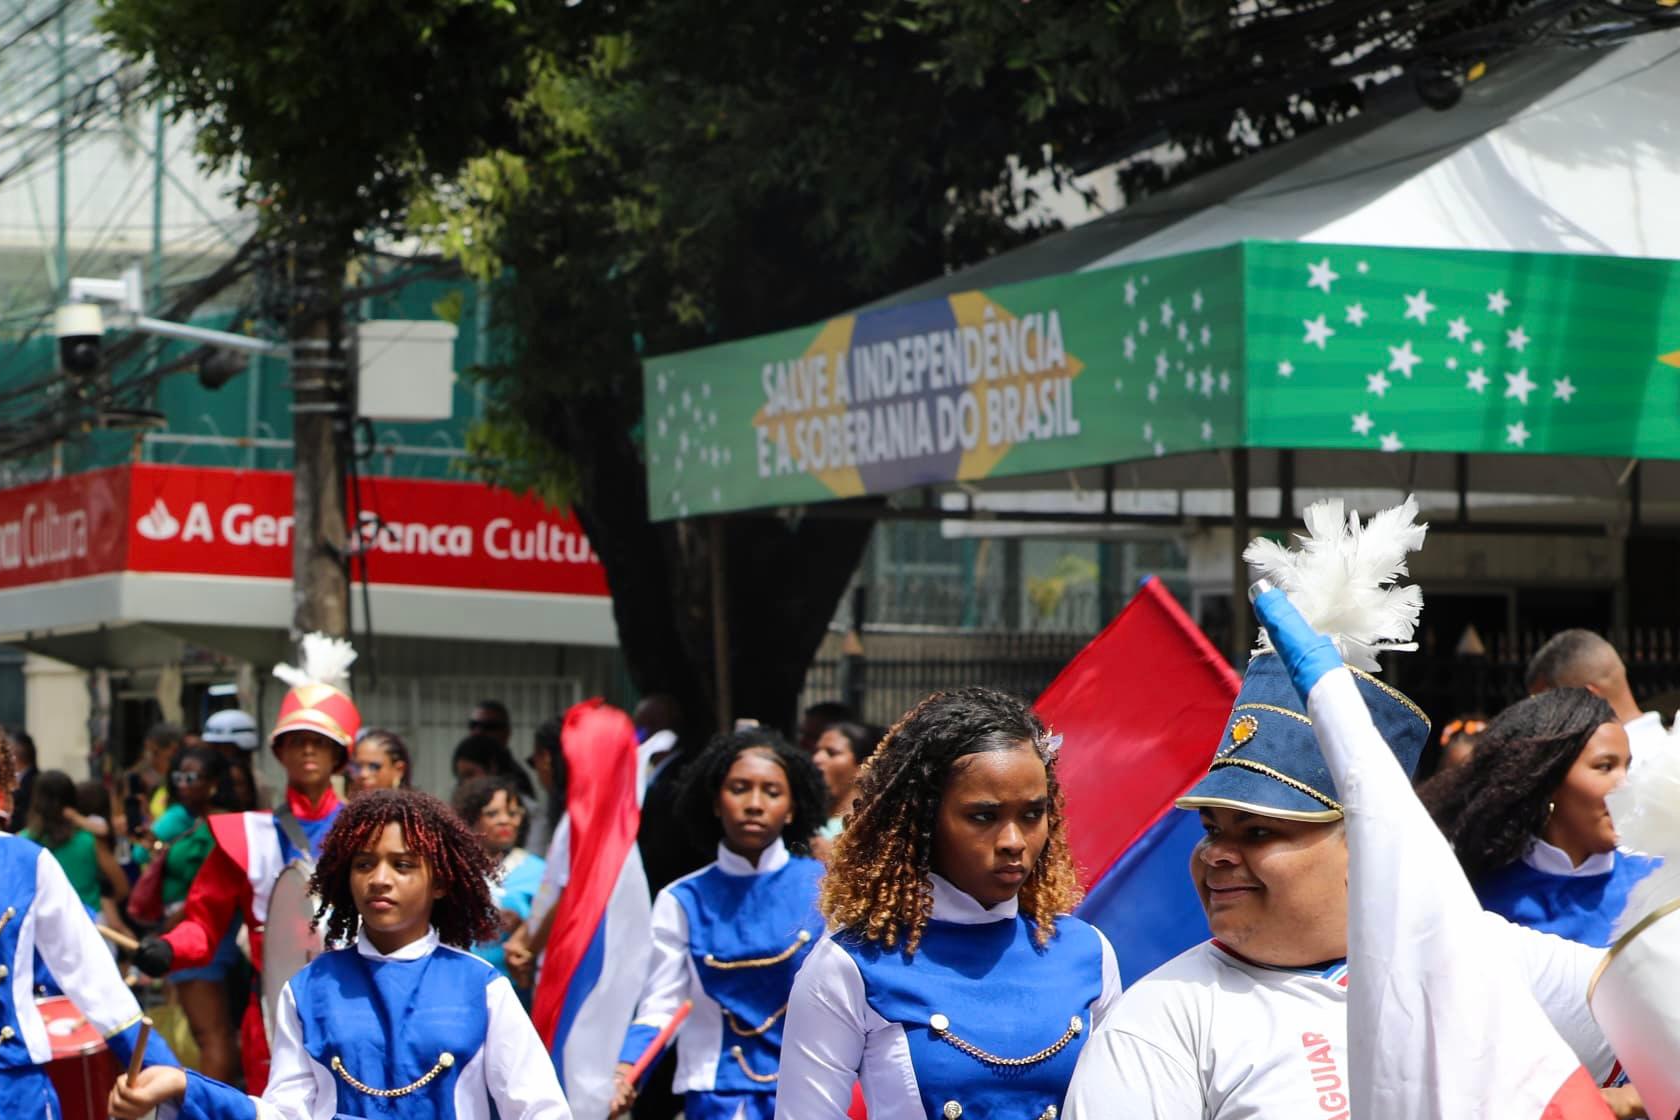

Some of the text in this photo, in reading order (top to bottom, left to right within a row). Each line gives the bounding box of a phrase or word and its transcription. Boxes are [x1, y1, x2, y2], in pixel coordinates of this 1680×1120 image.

[762, 306, 1065, 416] SALVE A INDEPENDÊNCIA
[757, 377, 1080, 478] E A SOBERANIA DO BRASIL
[24, 502, 88, 568] Cultura
[181, 501, 214, 543] A
[483, 517, 601, 565] Cultu
